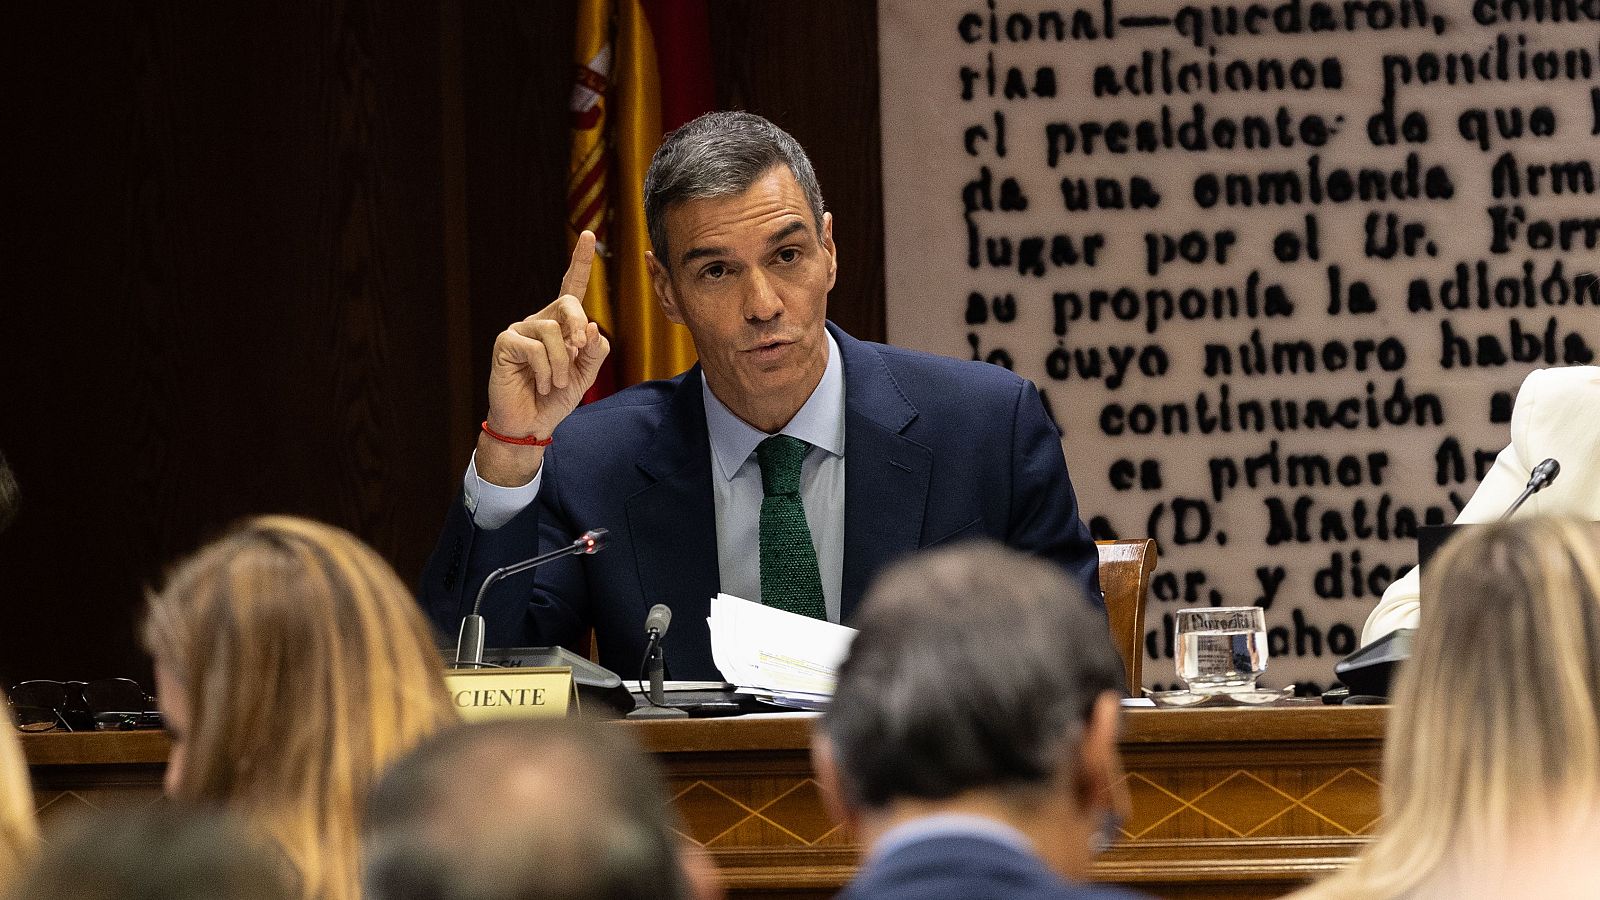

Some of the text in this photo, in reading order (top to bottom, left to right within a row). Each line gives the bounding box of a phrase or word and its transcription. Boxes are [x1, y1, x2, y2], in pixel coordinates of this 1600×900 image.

[1060, 175, 1162, 213] una
[966, 218, 1104, 277] lugar
[1144, 229, 1237, 277] por
[1327, 264, 1378, 316] la
[1203, 328, 1407, 378] número
[1099, 377, 1445, 437] continuación
[1253, 566, 1286, 611] y
[450, 688, 546, 708] CIENTE
